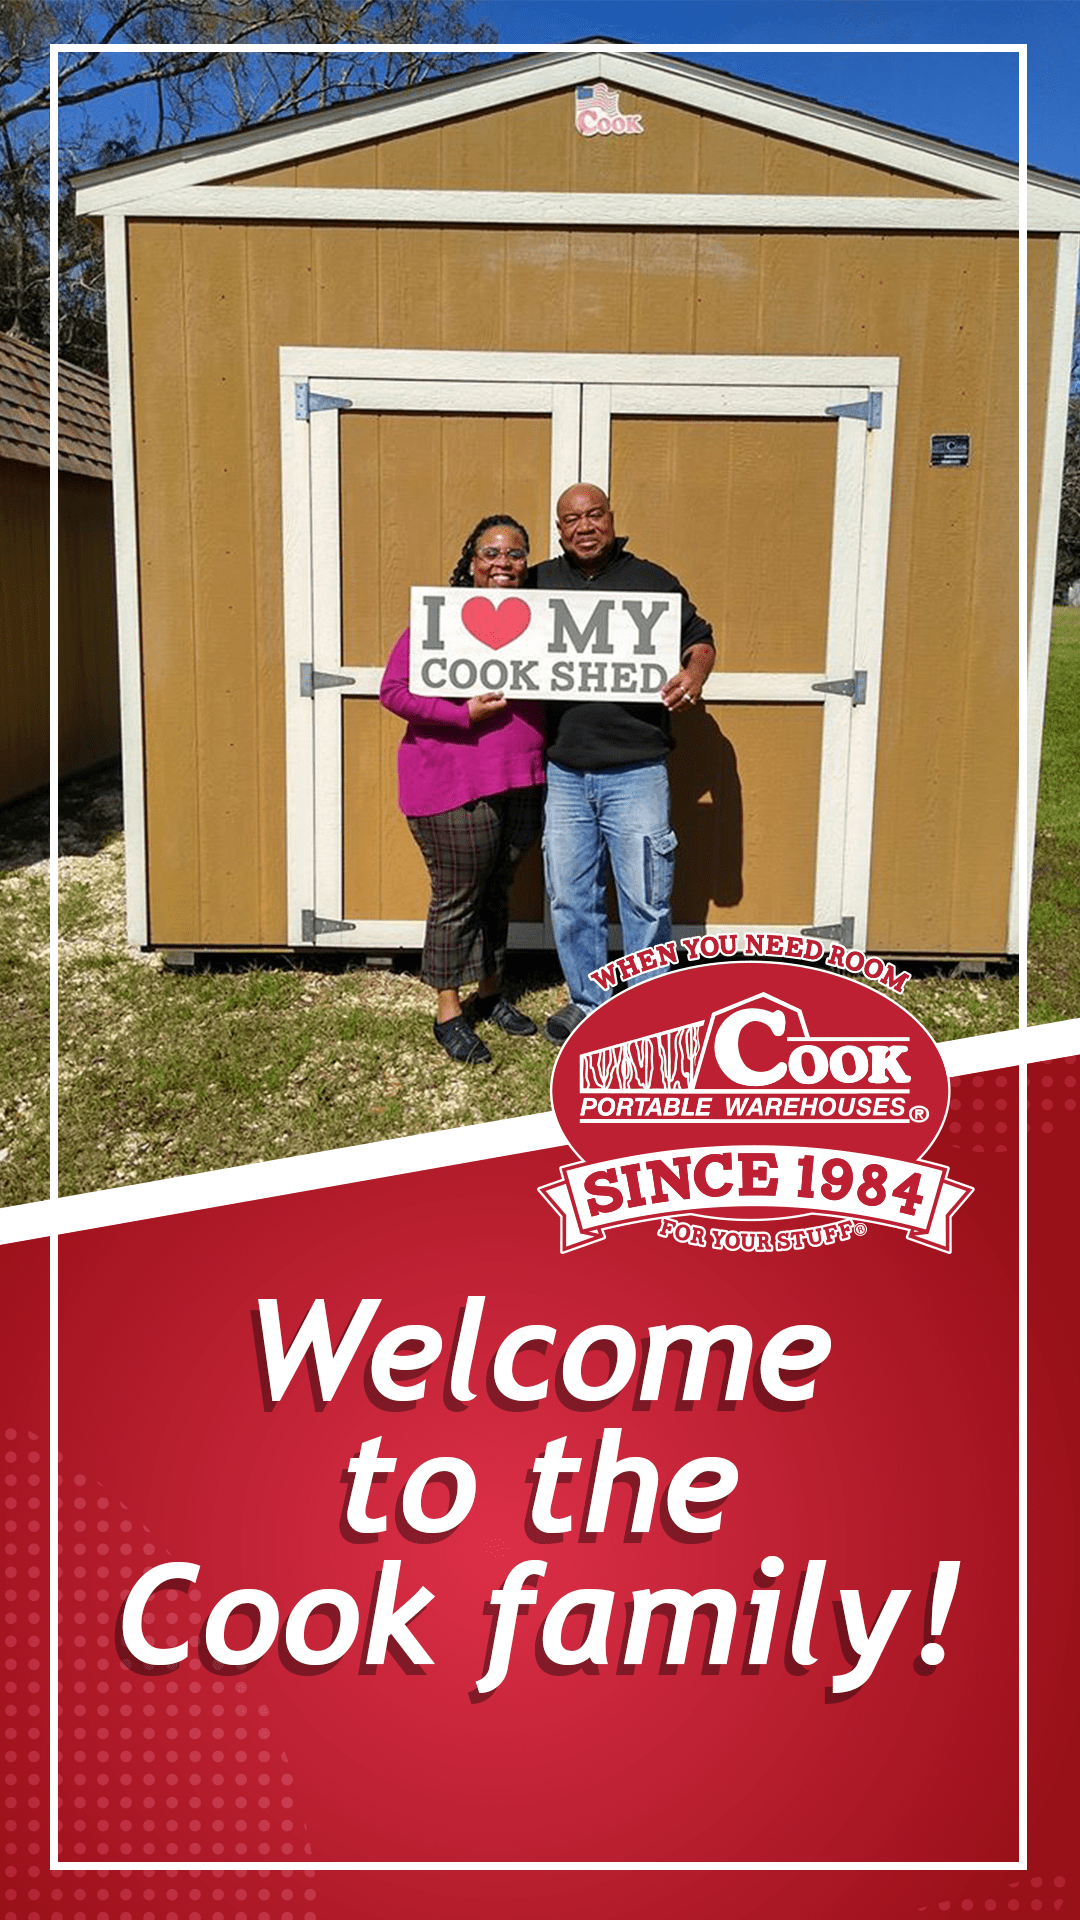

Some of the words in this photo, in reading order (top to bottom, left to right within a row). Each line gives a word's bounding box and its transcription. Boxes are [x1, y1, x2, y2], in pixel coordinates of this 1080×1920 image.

[422, 596, 446, 650] I
[548, 599, 669, 655] MY
[421, 658, 540, 691] COOK
[550, 661, 669, 694] SHED
